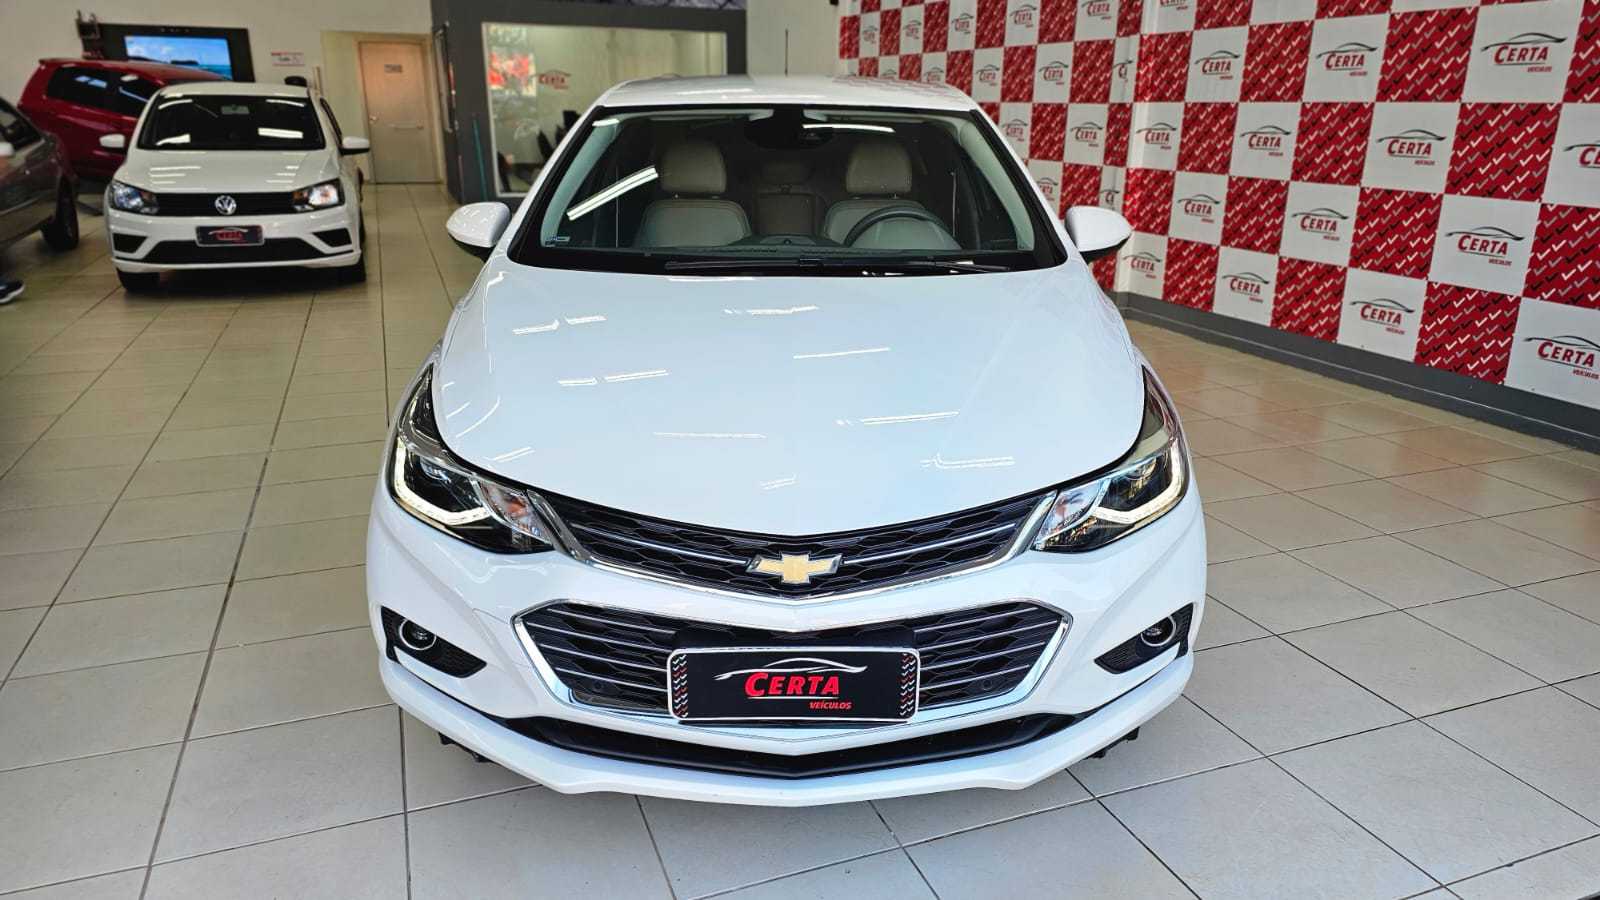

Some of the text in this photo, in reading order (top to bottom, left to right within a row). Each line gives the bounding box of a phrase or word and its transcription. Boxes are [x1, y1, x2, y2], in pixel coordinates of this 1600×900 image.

[1325, 53, 1365, 70] CERTA
[1494, 46, 1548, 64] CERTA
[1202, 60, 1231, 73] CERTA
[1145, 130, 1169, 143] CERTA
[1249, 134, 1281, 147] CERTA
[1387, 140, 1432, 156] CERTA
[1184, 201, 1212, 214] CERTA
[1301, 215, 1337, 232] CERTA
[1458, 235, 1508, 256] CERTA
[1131, 257, 1154, 271] CERTA
[1230, 278, 1260, 294] CERTA
[1360, 304, 1402, 325] CERTA
[1538, 341, 1595, 367] CERTA
[744, 672, 840, 697] CERTA
[809, 700, 853, 710] VEÍCULOS
